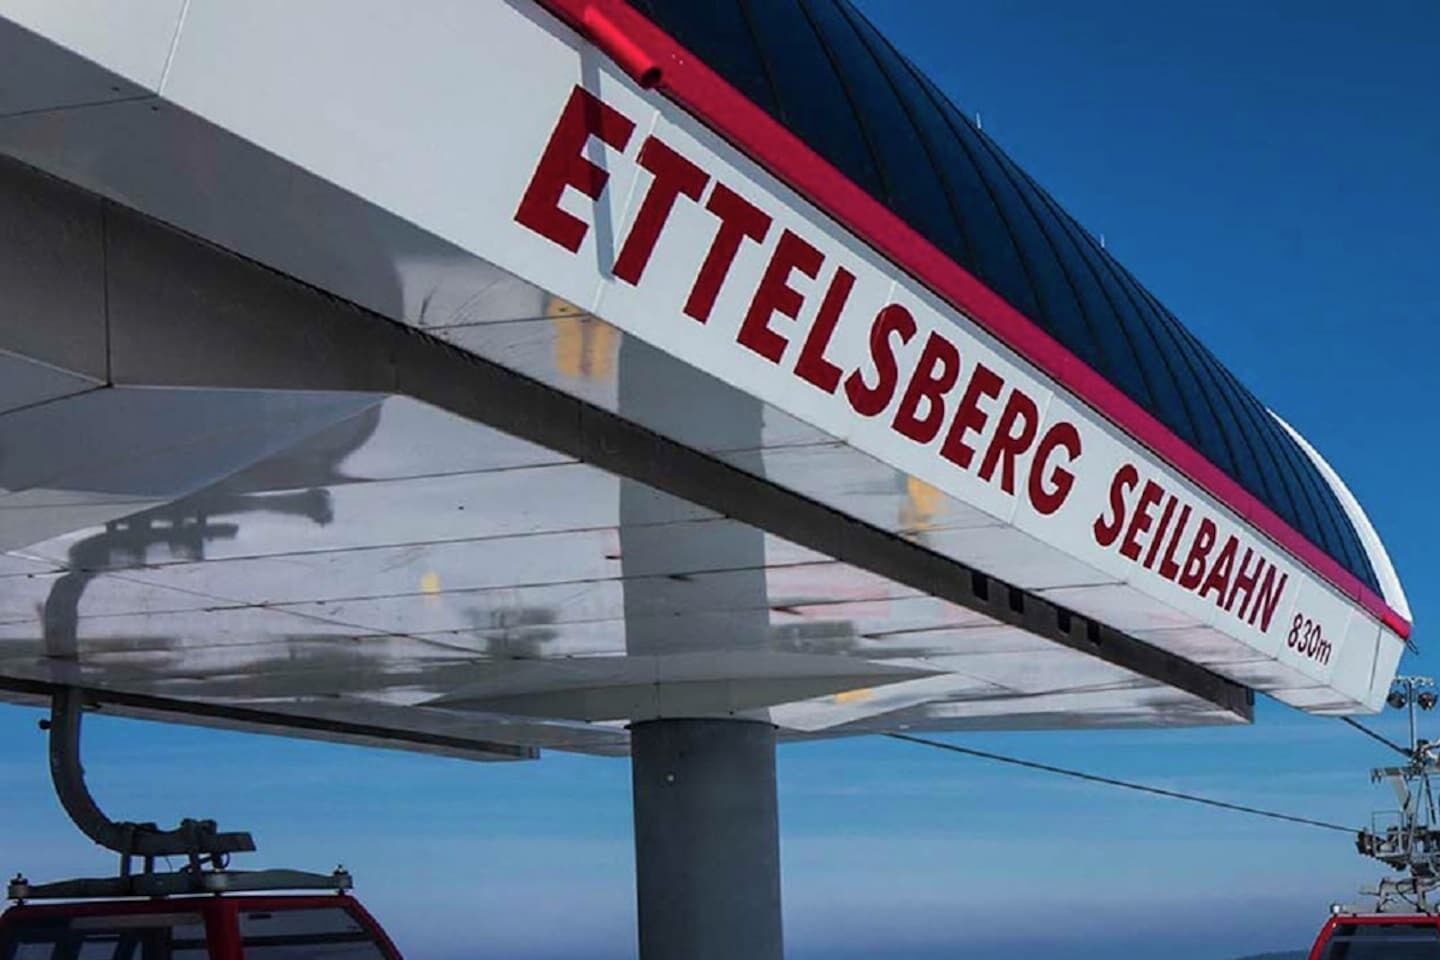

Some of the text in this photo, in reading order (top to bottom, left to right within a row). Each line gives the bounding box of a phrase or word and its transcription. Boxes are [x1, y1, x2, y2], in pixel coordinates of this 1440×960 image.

[514, 85, 1333, 666] ETTELSBERG SEILBAHN 830m
